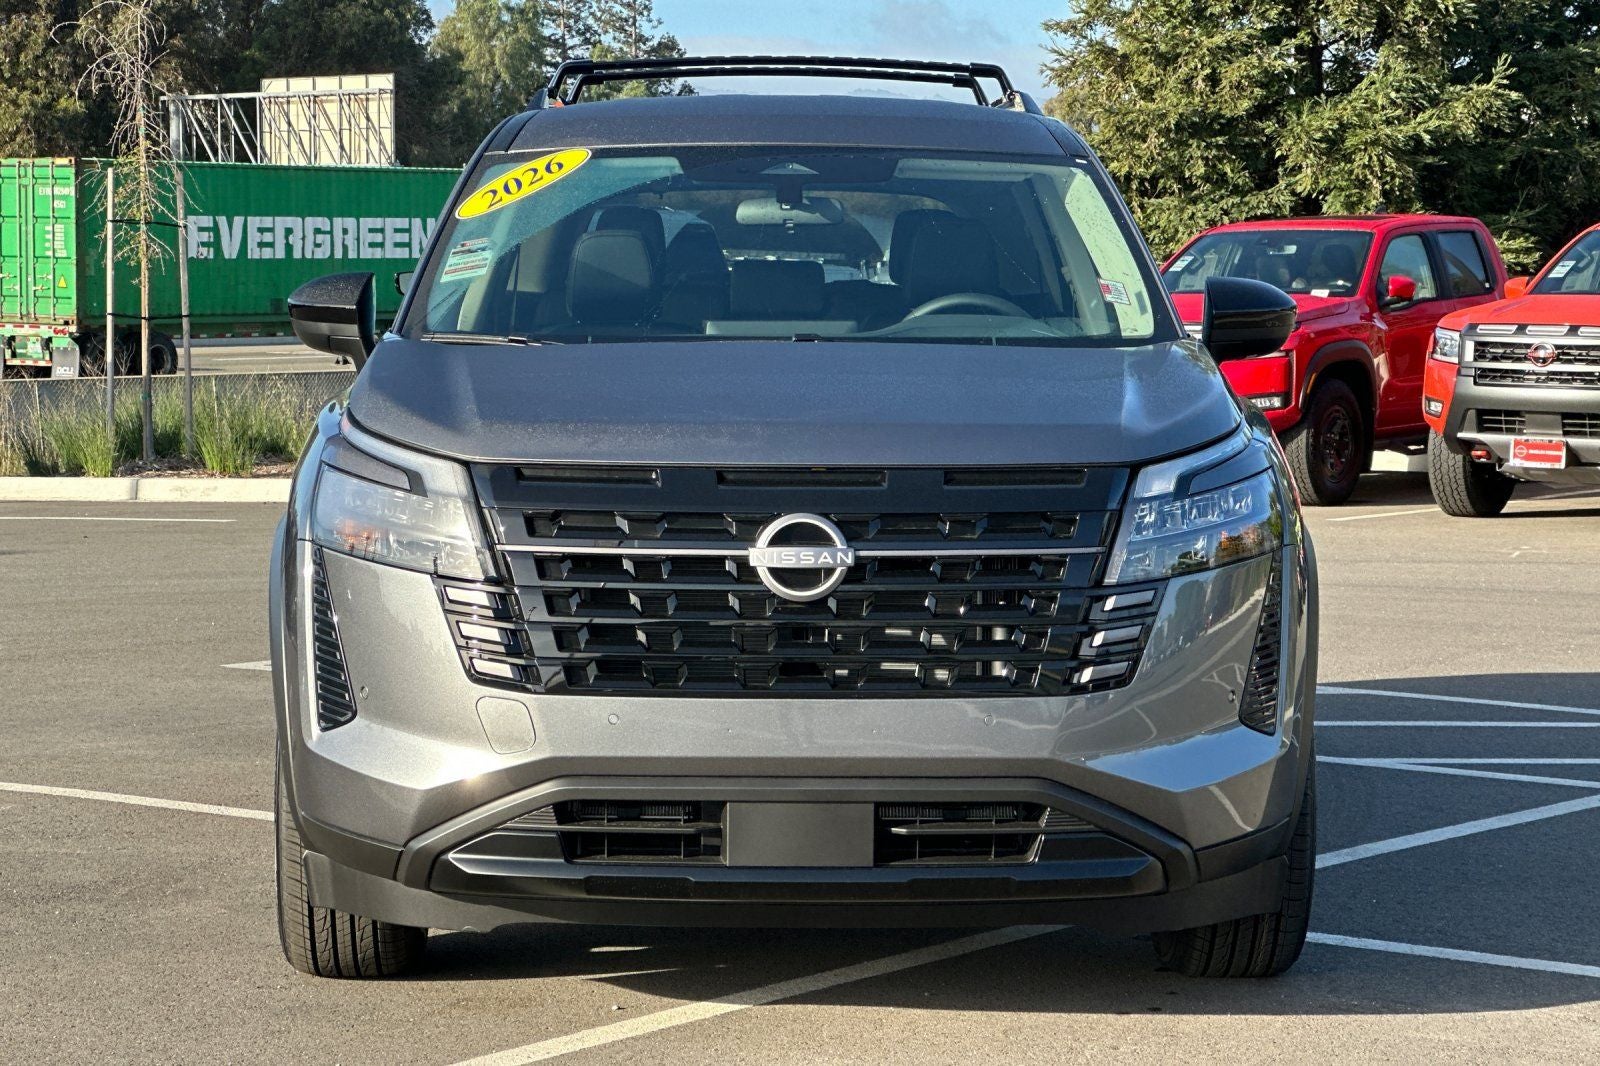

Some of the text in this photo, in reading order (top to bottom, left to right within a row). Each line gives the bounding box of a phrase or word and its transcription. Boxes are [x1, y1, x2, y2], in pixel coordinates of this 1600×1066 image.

[481, 155, 564, 209] 2026
[187, 215, 436, 259] EVERGREEN
[753, 551, 852, 564] NISSAN
